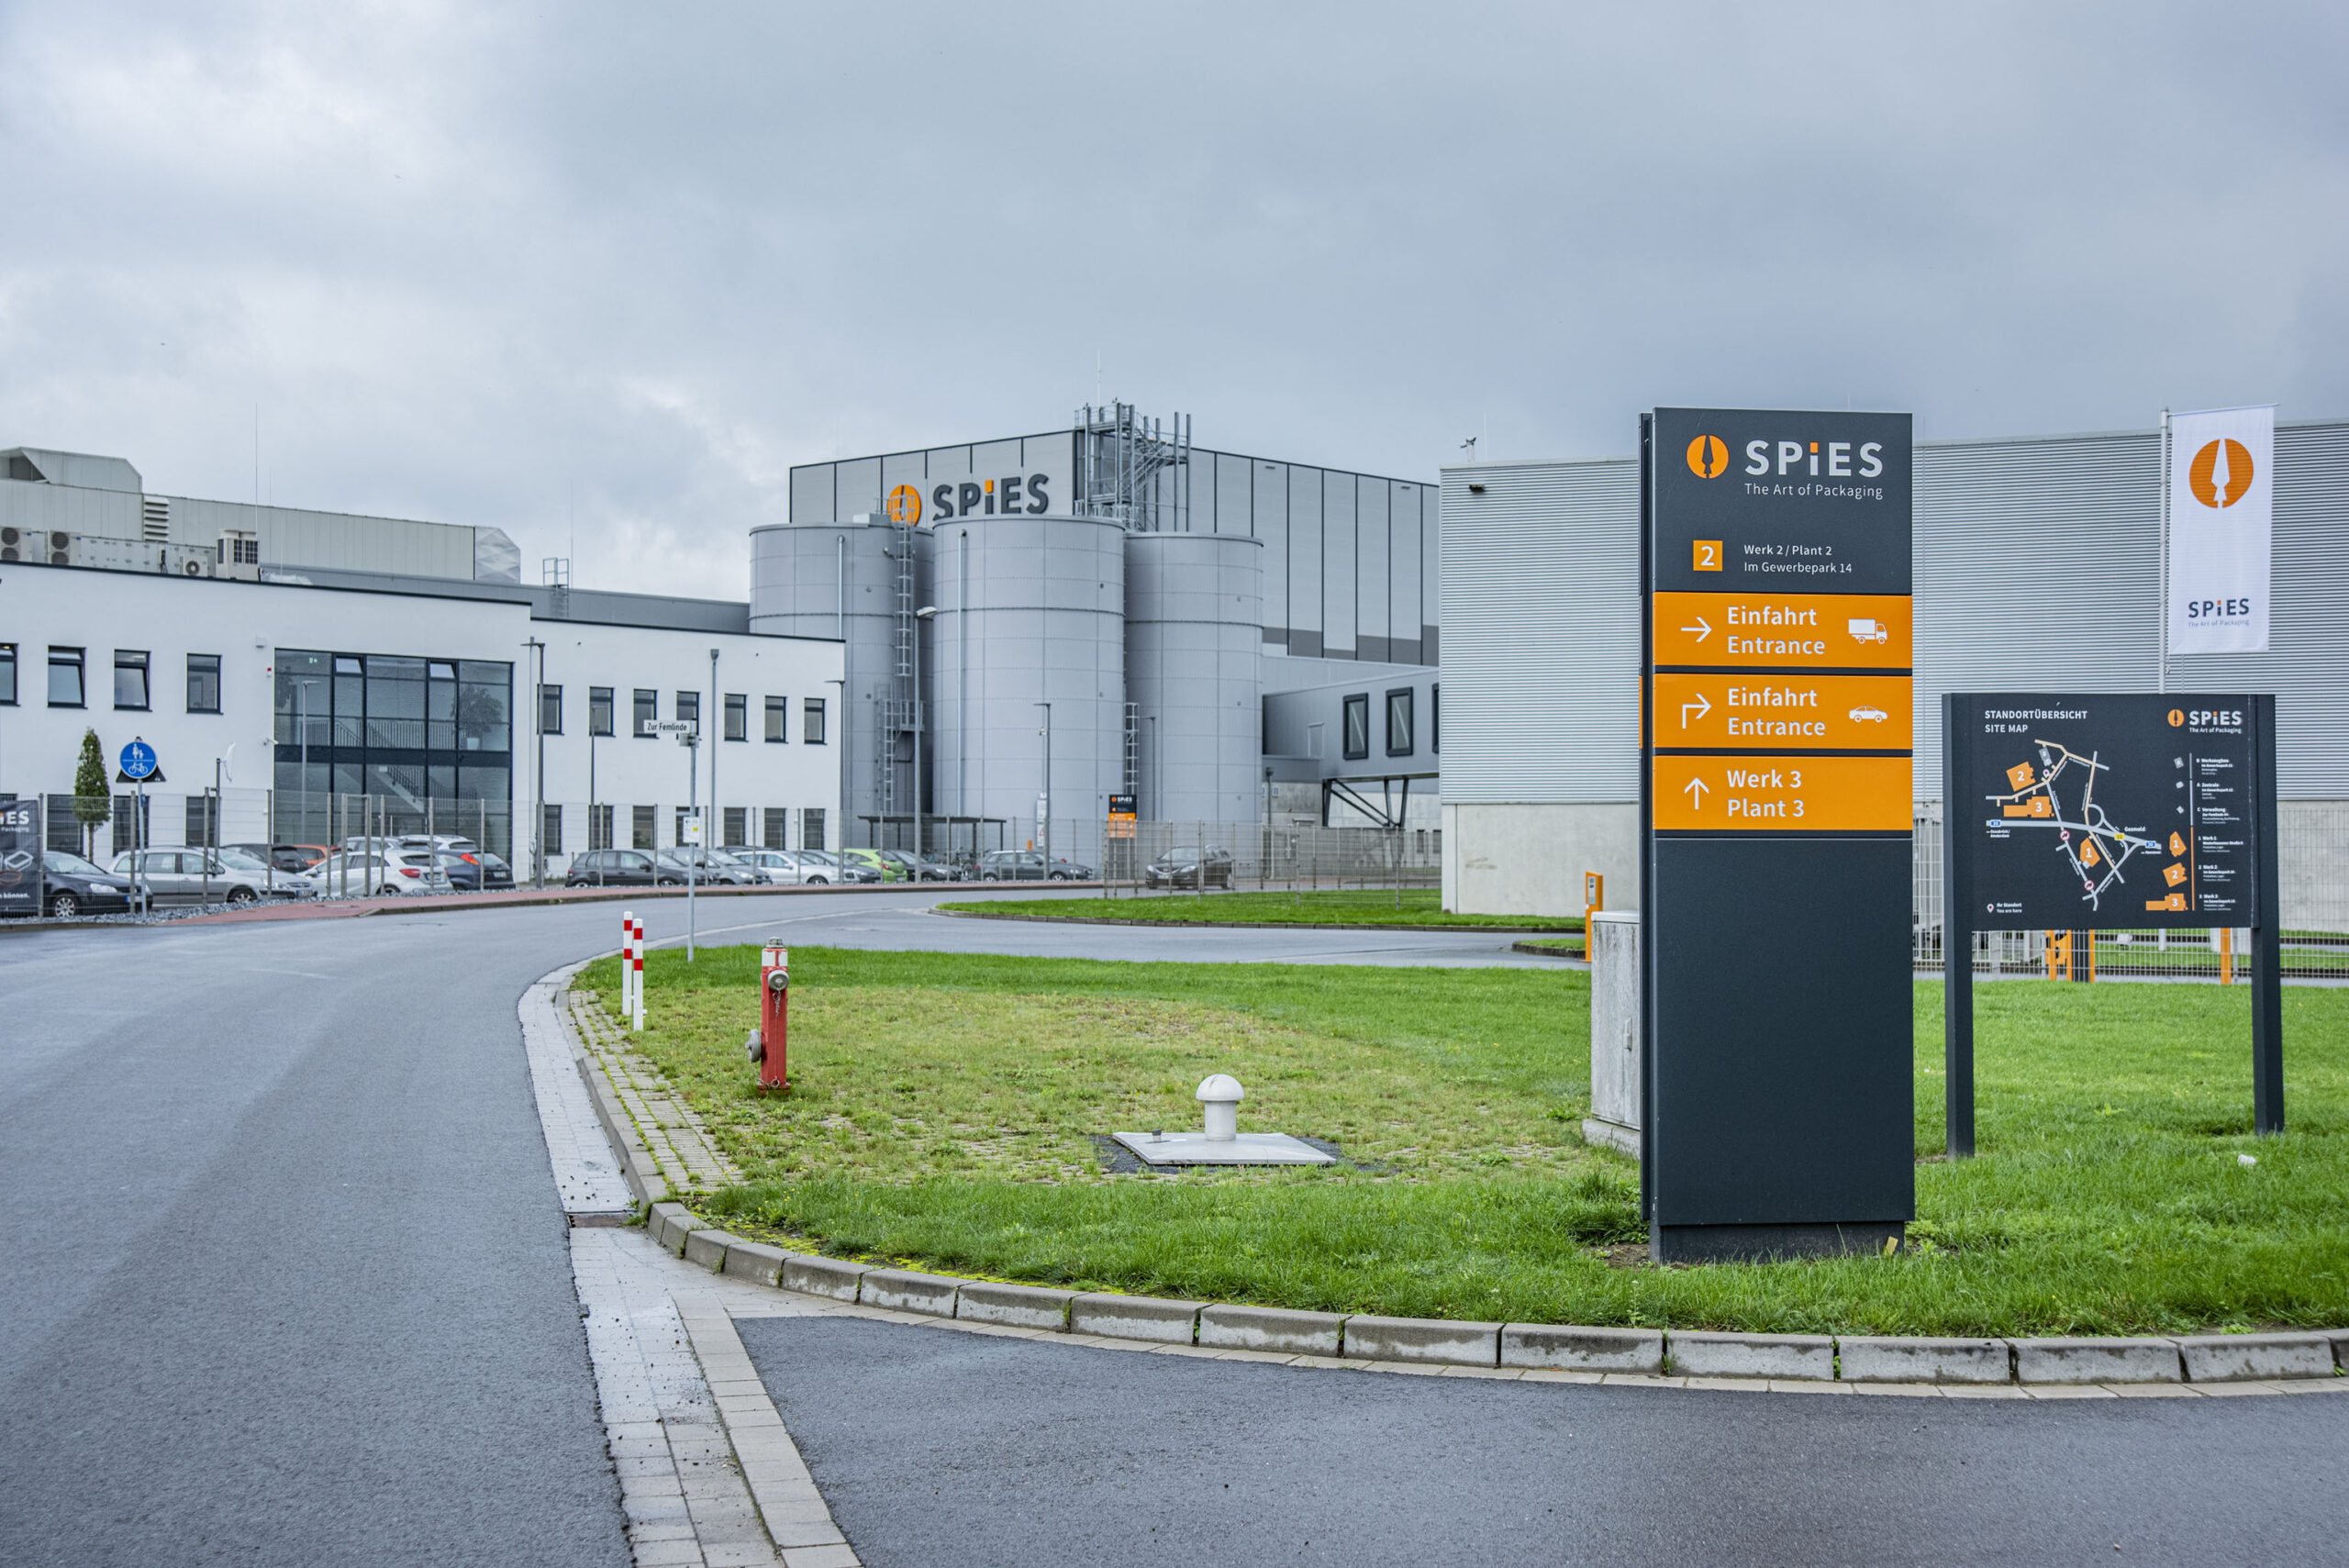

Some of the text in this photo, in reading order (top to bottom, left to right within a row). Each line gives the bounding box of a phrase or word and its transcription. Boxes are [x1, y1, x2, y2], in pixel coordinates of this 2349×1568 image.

[1744, 483, 1884, 501] The Art of Packaging
[1700, 545, 1715, 566] 2
[1744, 544, 1832, 557] Werk 2 / Plant 2
[1744, 562, 1852, 575] Im Gewerbepark 14
[1728, 605, 1818, 626] Einfahrt
[1728, 635, 1825, 654] Entrance
[1728, 686, 1818, 706] Einfahrt
[1985, 708, 2087, 719] STANDORTÜBERSICHT
[647, 722, 658, 730] Zur
[1728, 717, 1826, 736] Entrance
[1985, 724, 2028, 733] SITE MAP
[1727, 769, 1802, 788] Werk 3
[2017, 771, 2024, 782] 2
[1728, 798, 1805, 817] Plant 3
[2035, 802, 2043, 813] 3
[2173, 840, 2179, 849] 1
[2086, 848, 2092, 858] 1
[2172, 870, 2178, 879] 2
[2172, 898, 2178, 906] 3
